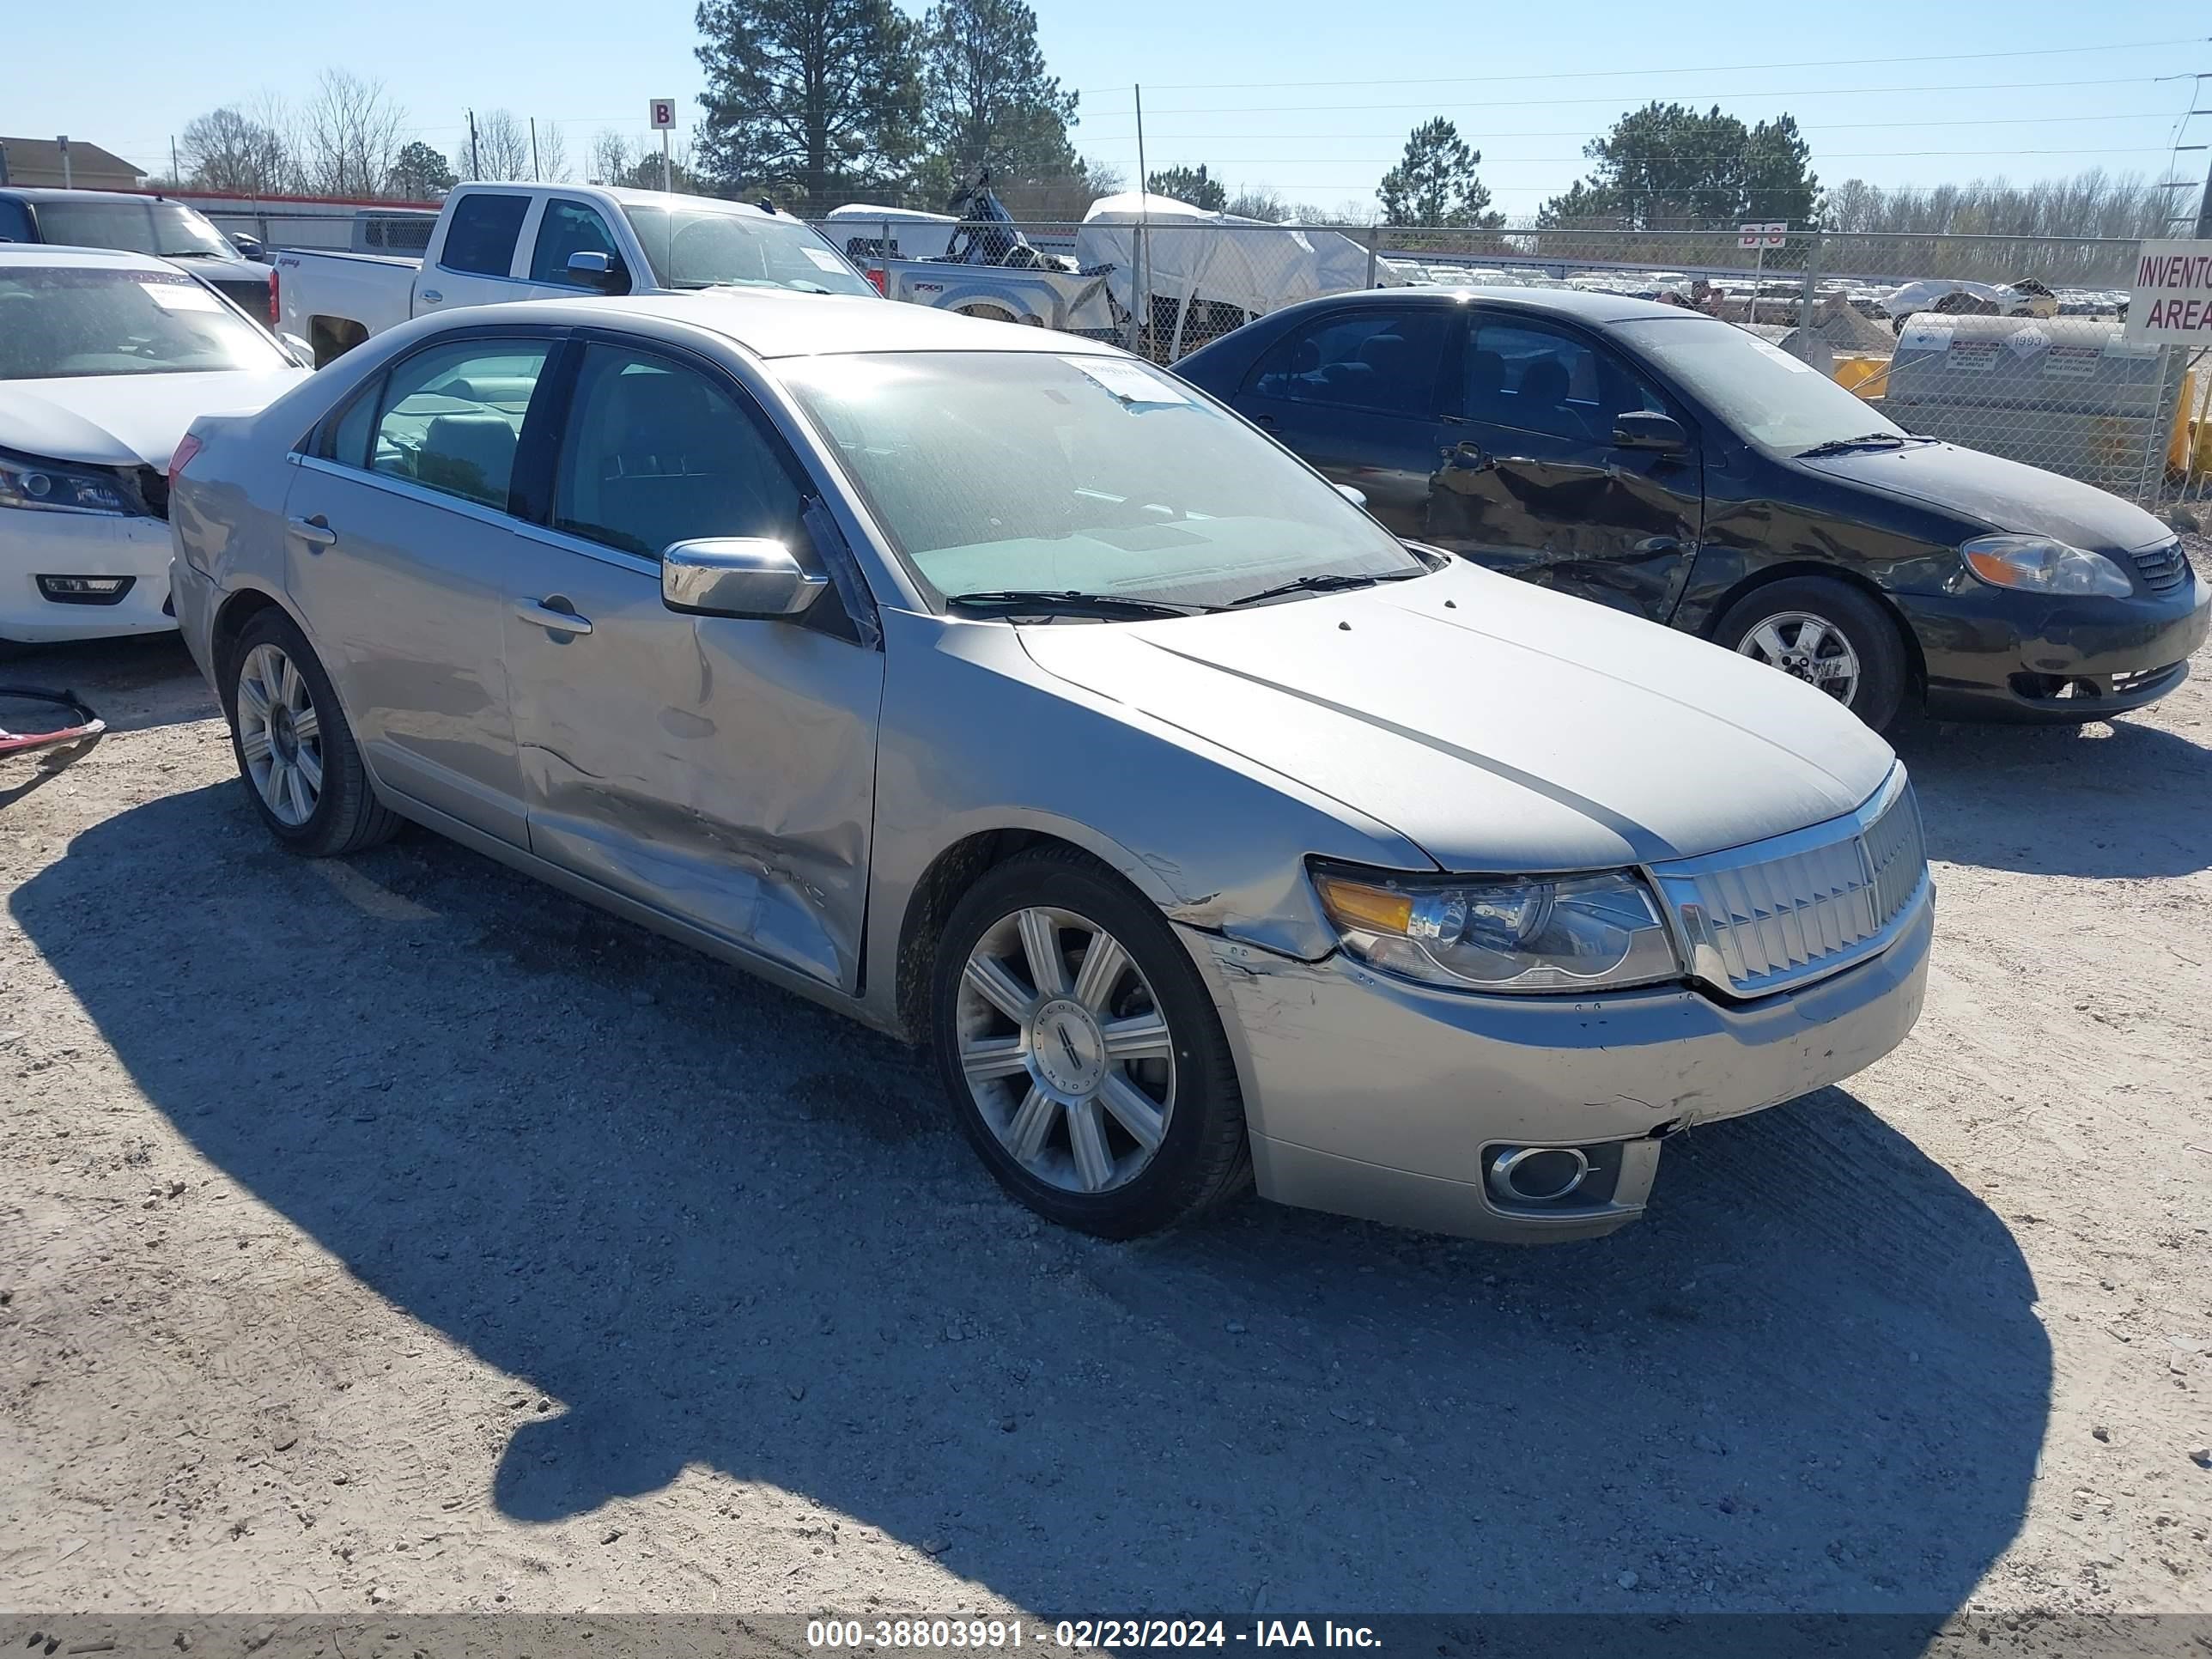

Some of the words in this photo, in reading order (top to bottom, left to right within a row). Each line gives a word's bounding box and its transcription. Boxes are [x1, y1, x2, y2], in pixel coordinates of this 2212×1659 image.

[656, 104, 670, 124] B
[2145, 299, 2212, 330] AREA
[2014, 336, 2042, 347] 1993
